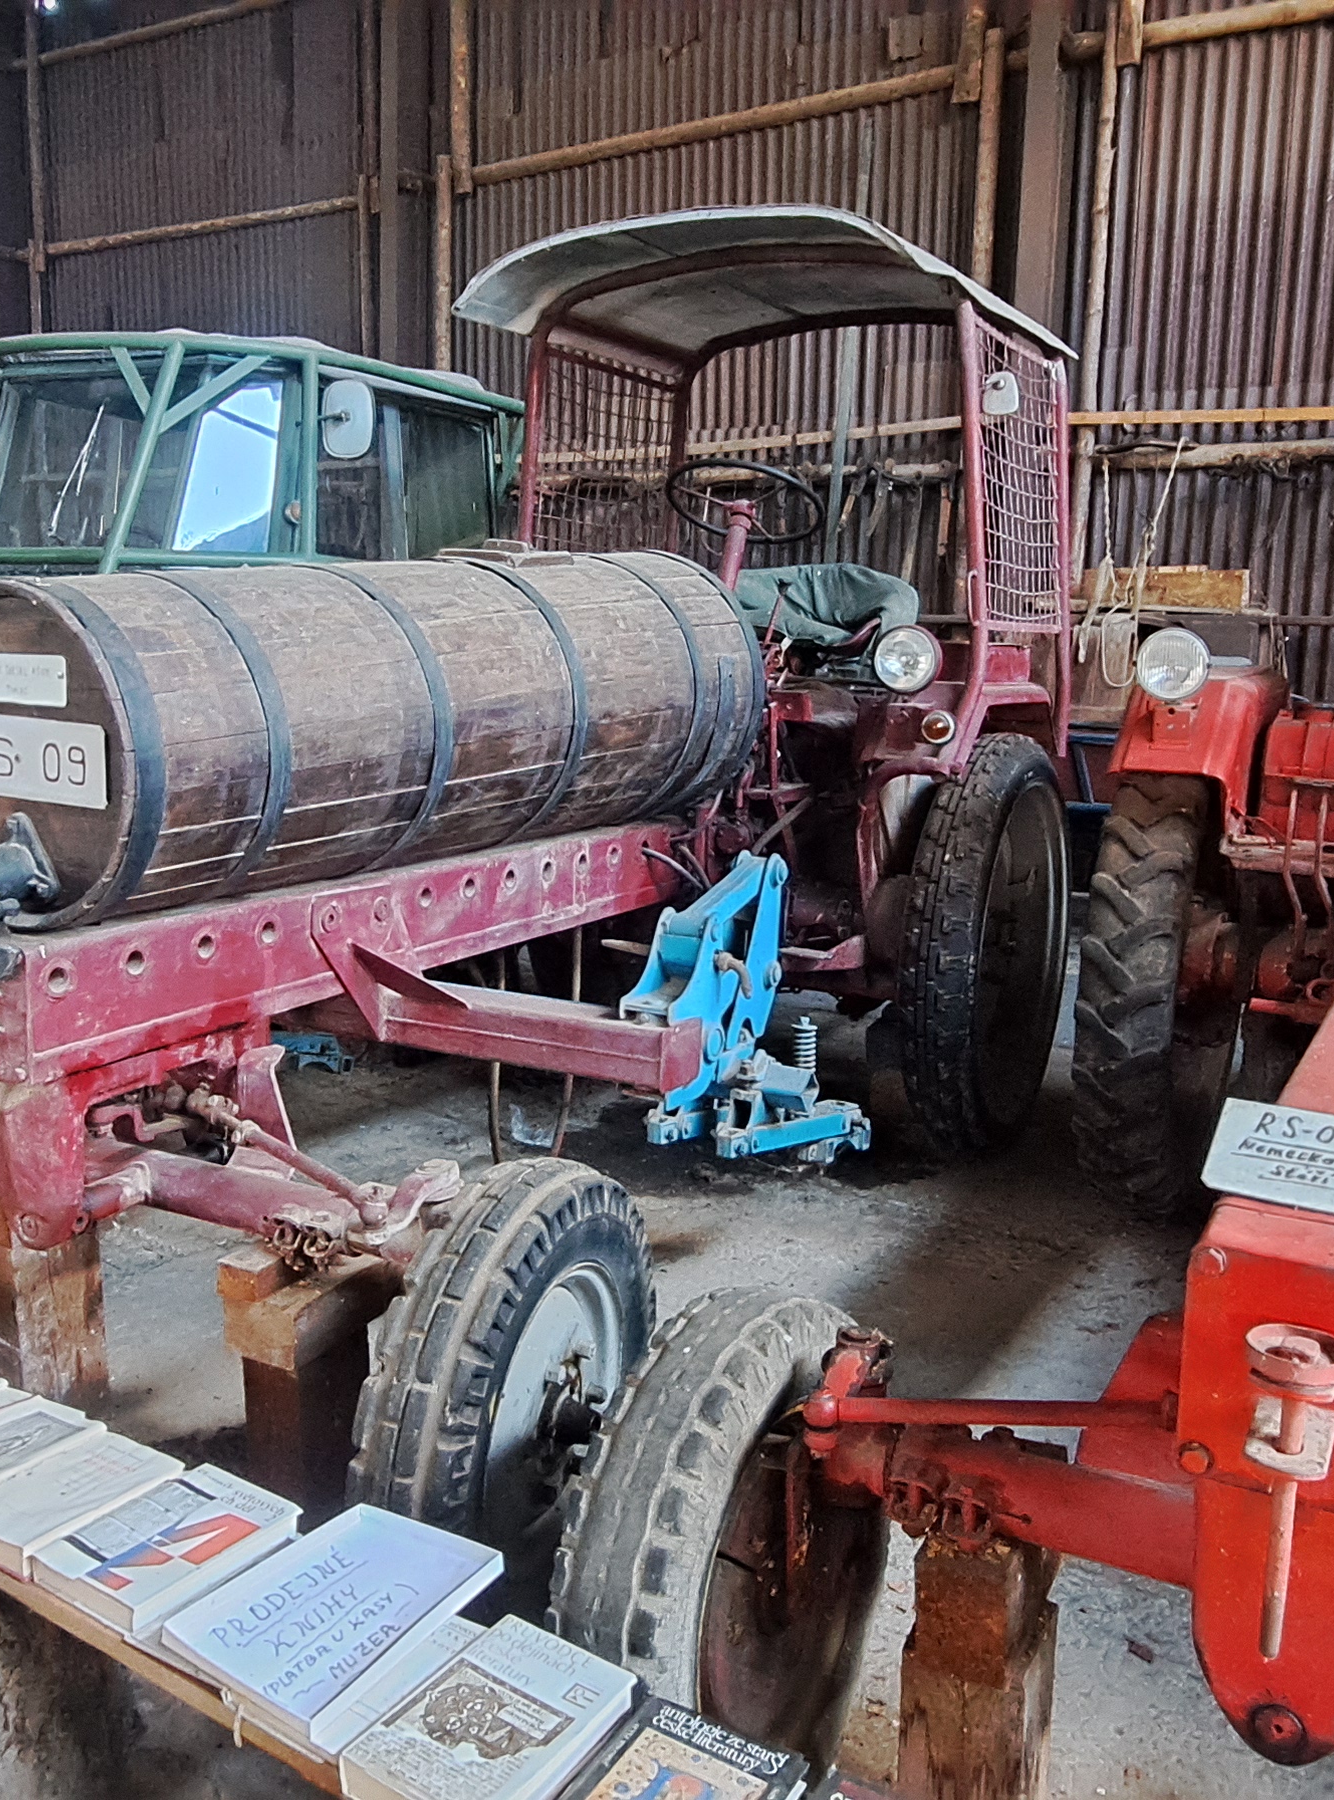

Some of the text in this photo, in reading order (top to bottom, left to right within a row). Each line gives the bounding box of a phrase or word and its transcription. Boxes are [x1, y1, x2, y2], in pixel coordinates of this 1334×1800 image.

[42, 742, 87, 787] 09
[208, 1545, 355, 1649] PRODEJNÉ
[264, 1583, 359, 1657] KNIHY
